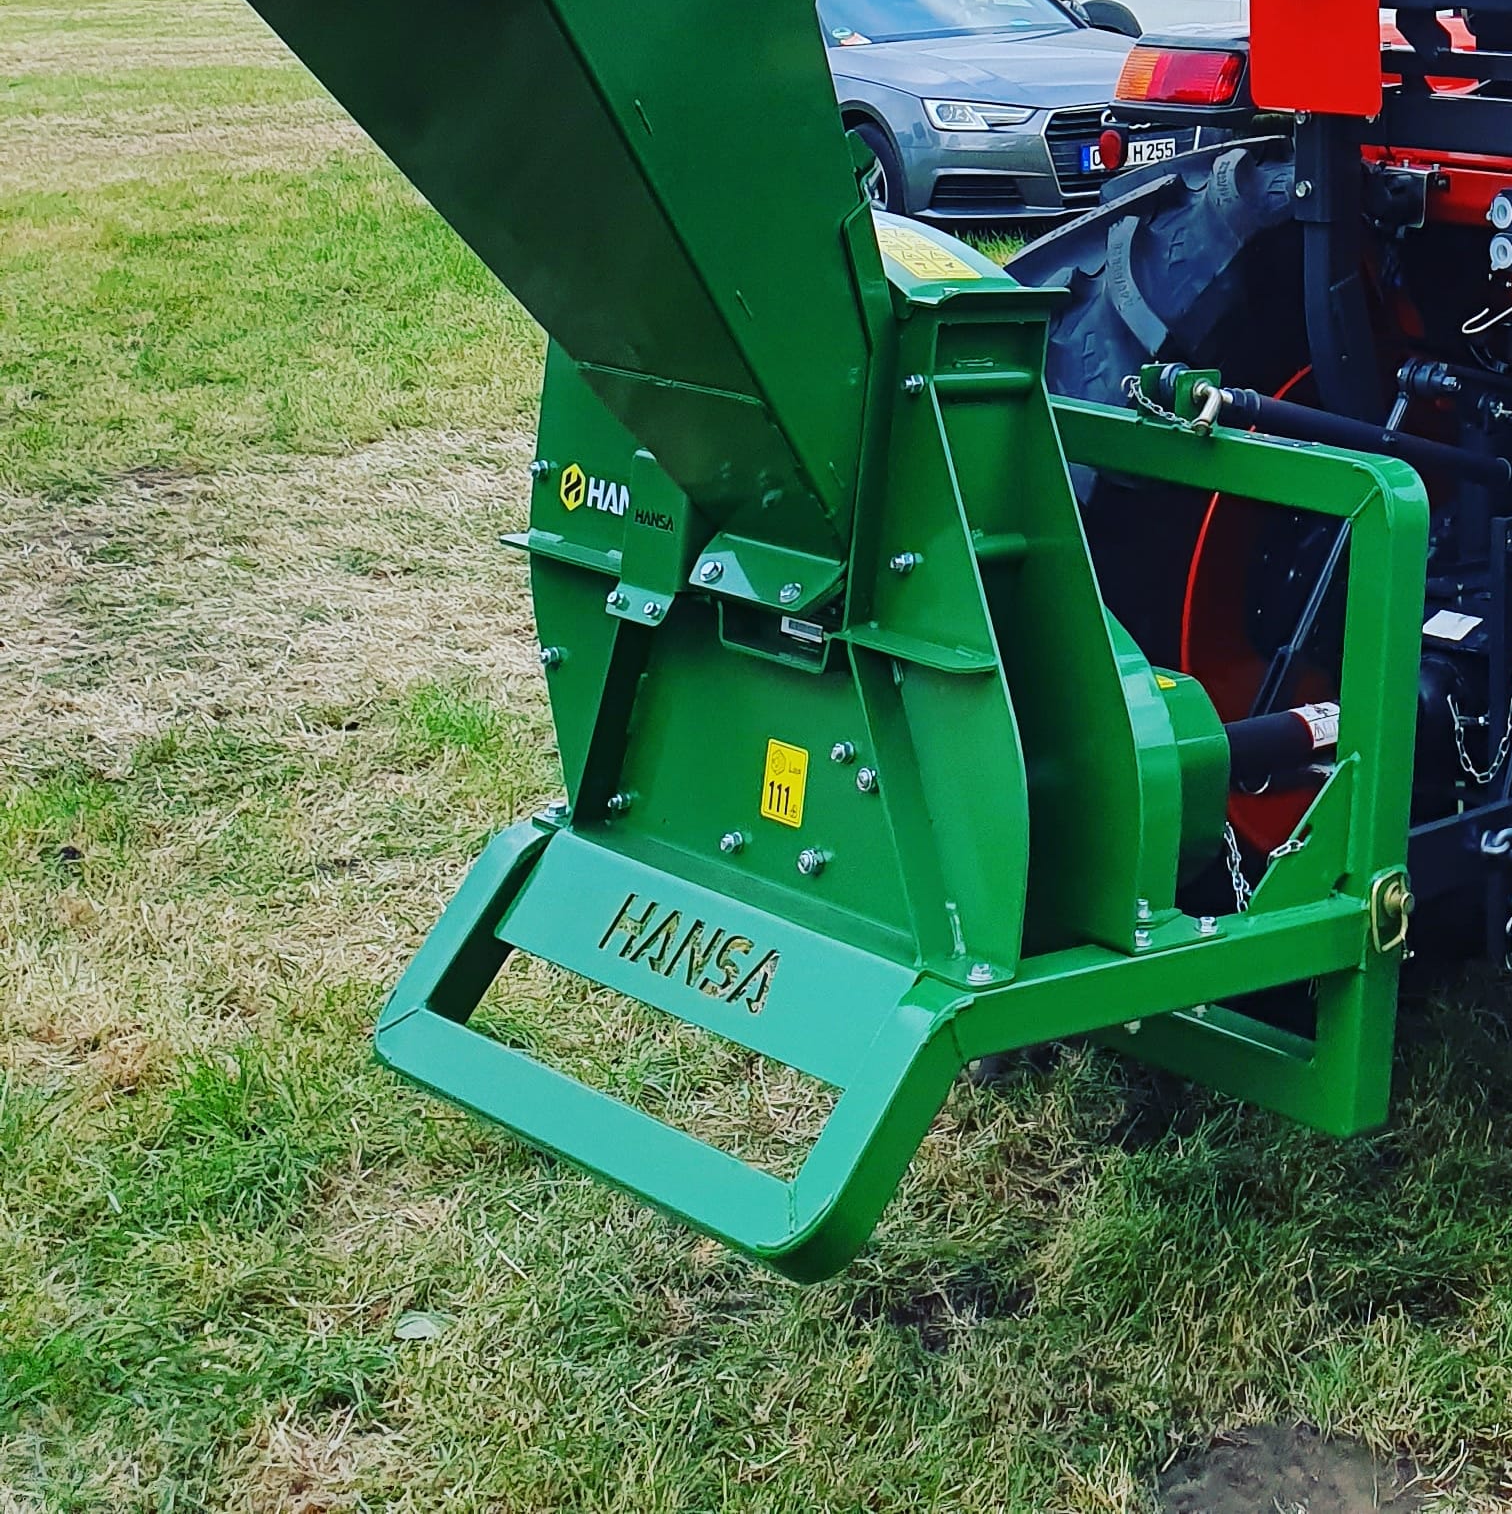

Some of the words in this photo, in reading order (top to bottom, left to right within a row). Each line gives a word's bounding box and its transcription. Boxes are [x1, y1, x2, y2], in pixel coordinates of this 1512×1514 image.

[1093, 149, 1101, 166] O
[1133, 145, 1143, 162] H
[1146, 142, 1173, 160] 255
[586, 476, 629, 516] HAN
[634, 509, 674, 533] HANSA
[768, 780, 790, 815] 111
[598, 893, 780, 1014] HANSA
